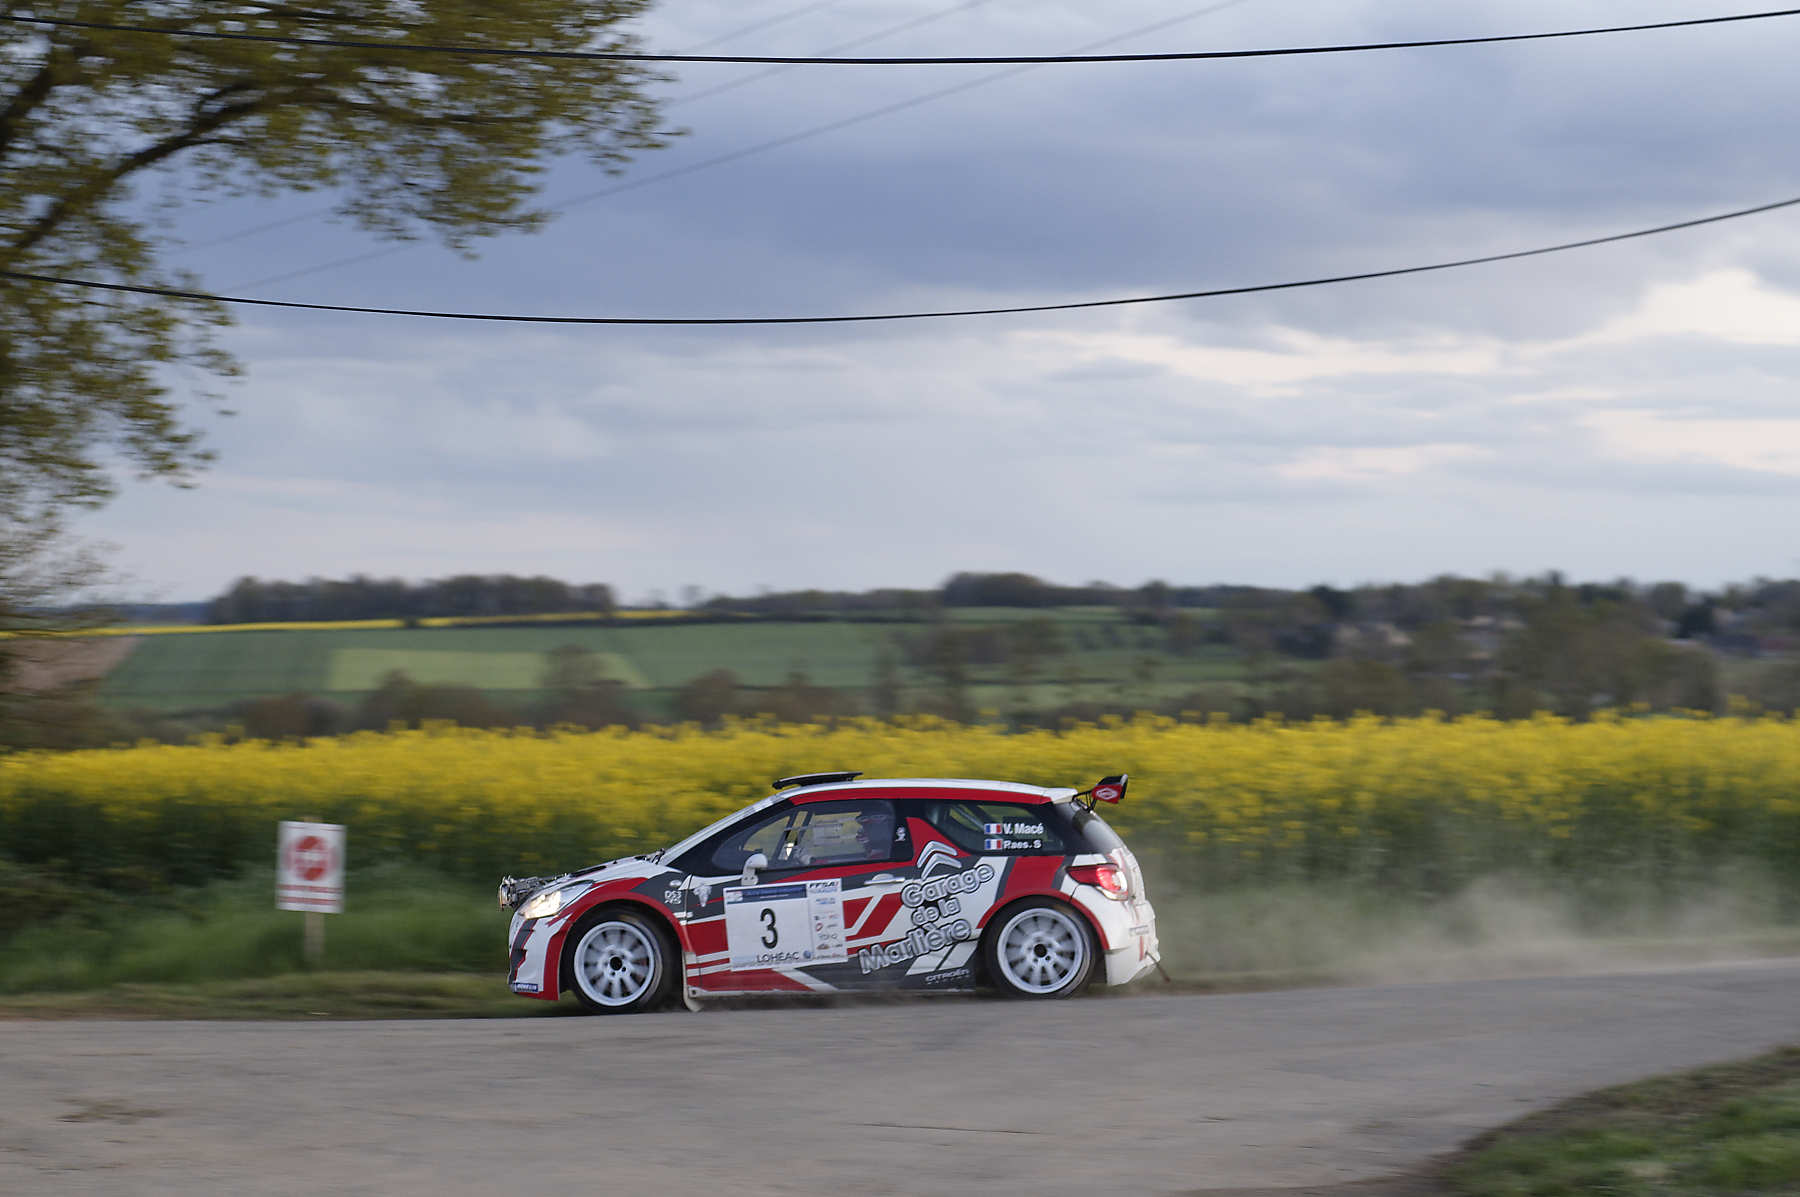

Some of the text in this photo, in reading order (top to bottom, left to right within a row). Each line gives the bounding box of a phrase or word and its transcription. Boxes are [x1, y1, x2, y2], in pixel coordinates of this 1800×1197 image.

[1003, 822, 1044, 835] V. Macé
[902, 864, 994, 908] Garage
[759, 908, 779, 950] 3
[912, 898, 961, 927] de la
[858, 919, 972, 975] Marlière
